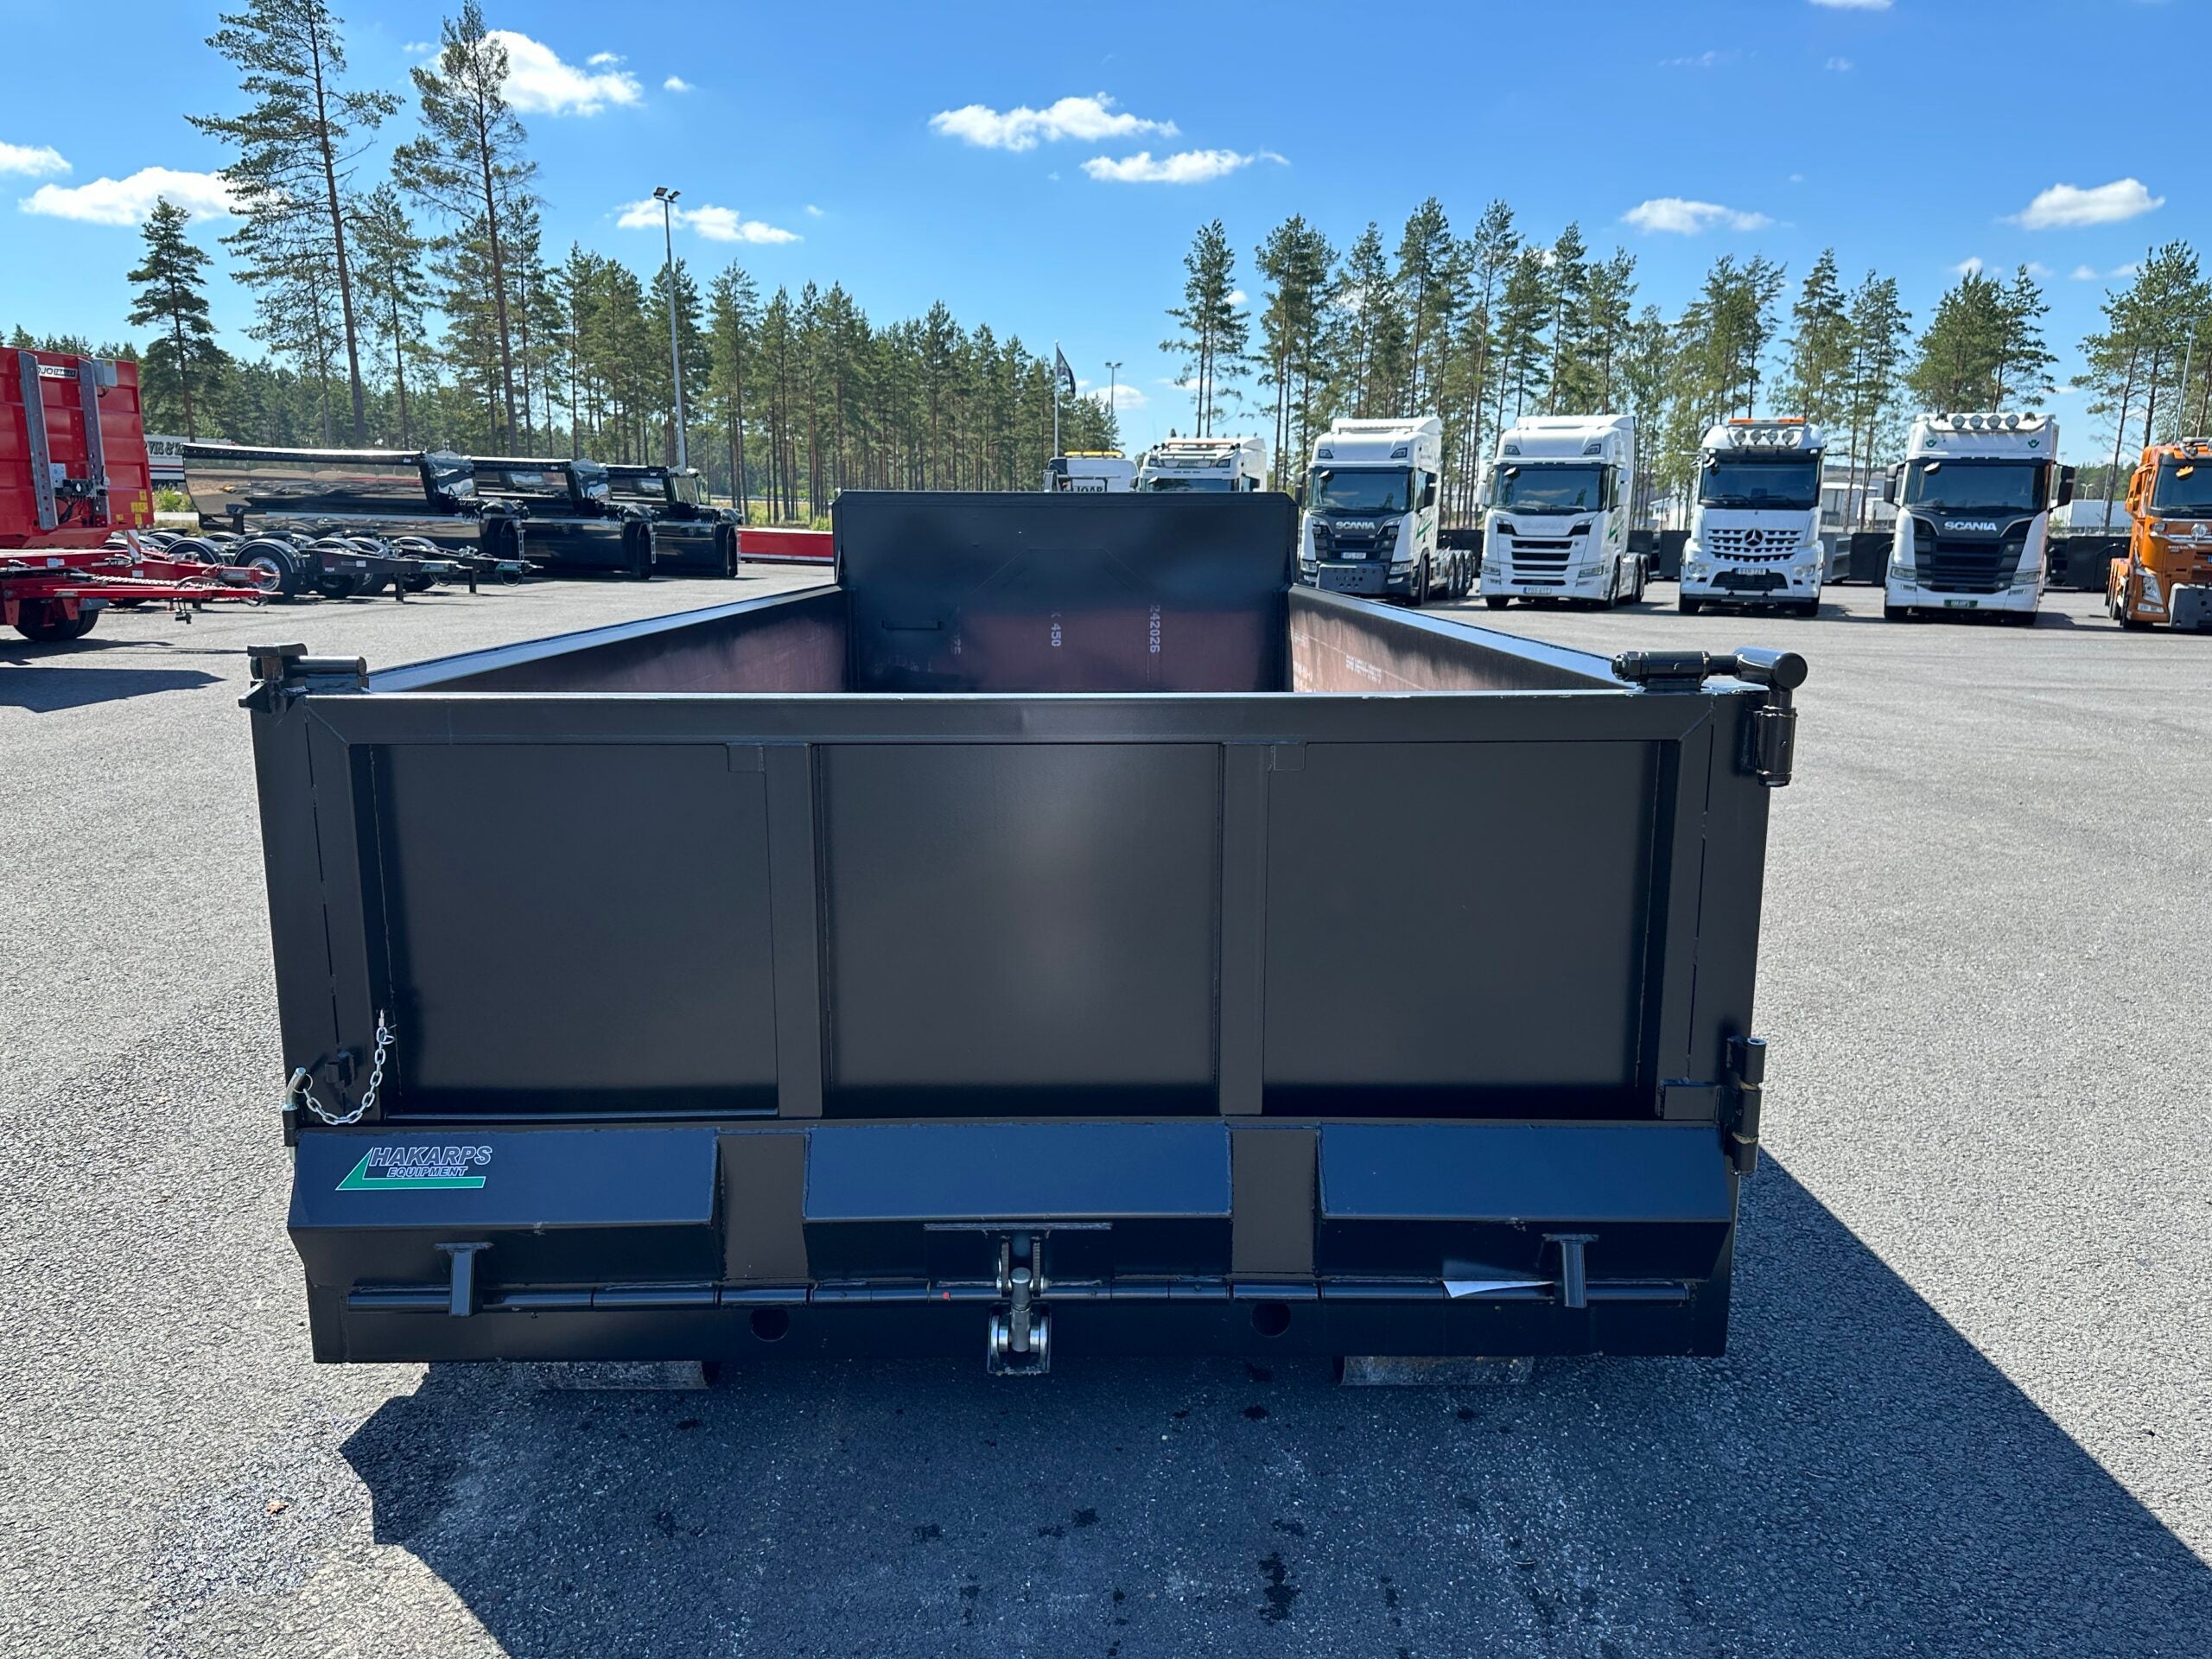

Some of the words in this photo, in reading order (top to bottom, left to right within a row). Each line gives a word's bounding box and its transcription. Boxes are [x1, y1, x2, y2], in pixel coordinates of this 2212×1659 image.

[1335, 520, 1376, 530] SCANIA
[1944, 521, 1998, 531] SCANIA
[1051, 622, 1062, 647] 450
[1149, 604, 1160, 653] 242026
[369, 1145, 493, 1167] HAKARPS
[386, 1166, 468, 1179] EQUIPMENT
